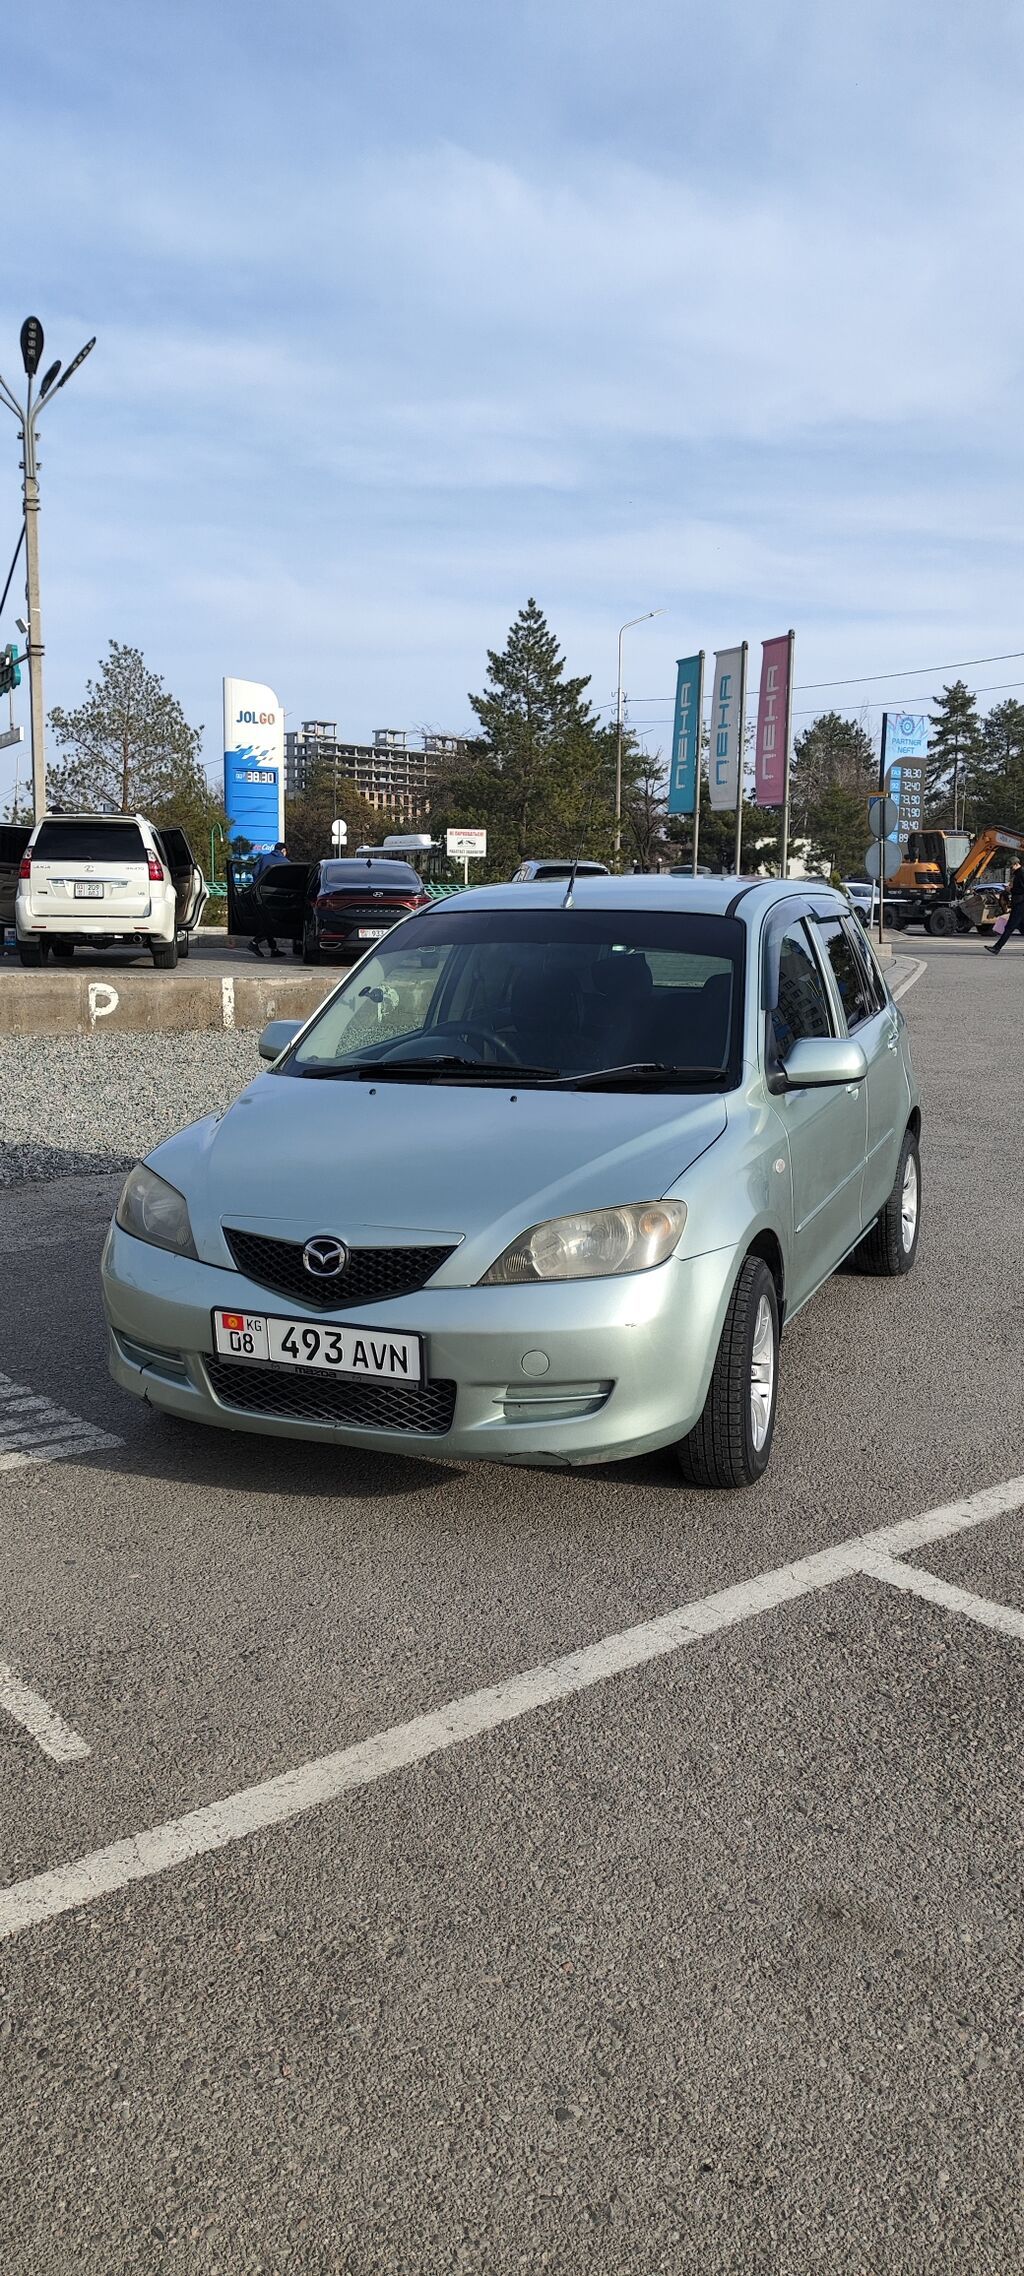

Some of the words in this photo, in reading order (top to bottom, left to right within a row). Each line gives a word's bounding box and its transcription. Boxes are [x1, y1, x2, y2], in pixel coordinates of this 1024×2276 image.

[236, 710, 276, 726] JOLGO
[891, 737, 922, 746] PARTNER
[246, 1318, 262, 1331] KG
[229, 1331, 254, 1354] 08
[281, 1326, 343, 1364] 493
[352, 1340, 408, 1374] AVN
[294, 1366, 337, 1379] mazda
